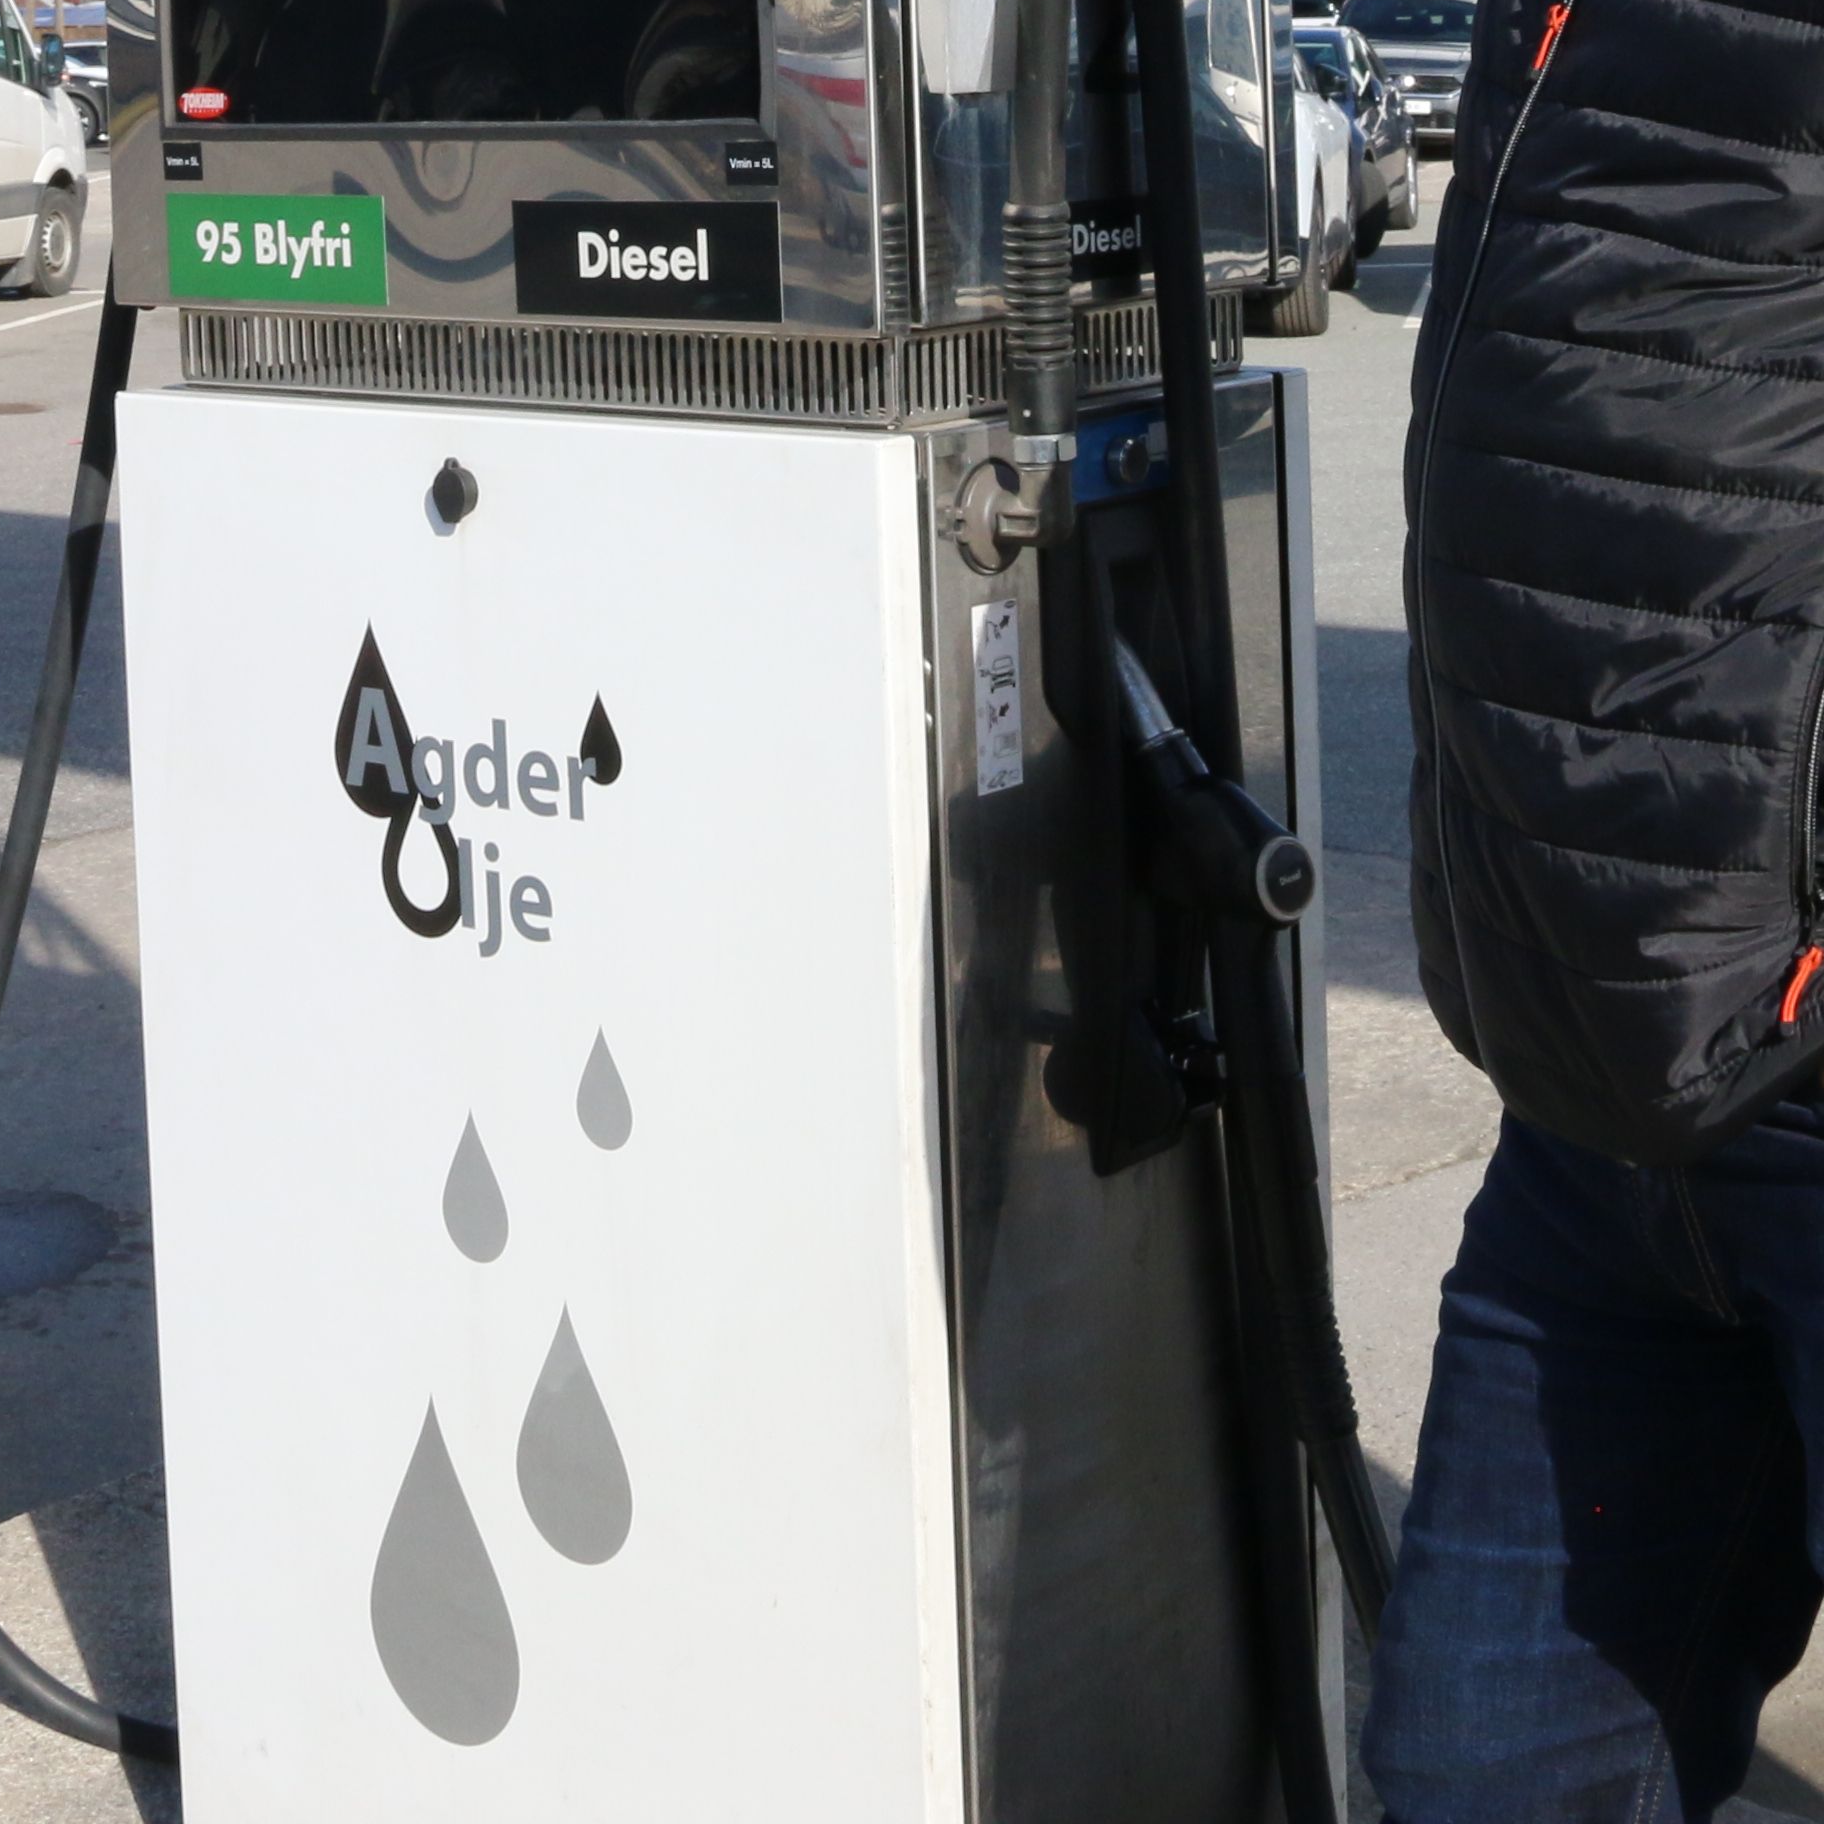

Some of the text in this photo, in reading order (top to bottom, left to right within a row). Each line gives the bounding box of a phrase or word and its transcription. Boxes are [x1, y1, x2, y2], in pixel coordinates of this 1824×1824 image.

[729, 157, 753, 169] Vmin
[195, 219, 353, 279] 95 Blyfri
[577, 228, 710, 282] Diesel
[1072, 213, 1142, 256] Diesel
[344, 686, 597, 826] Agder
